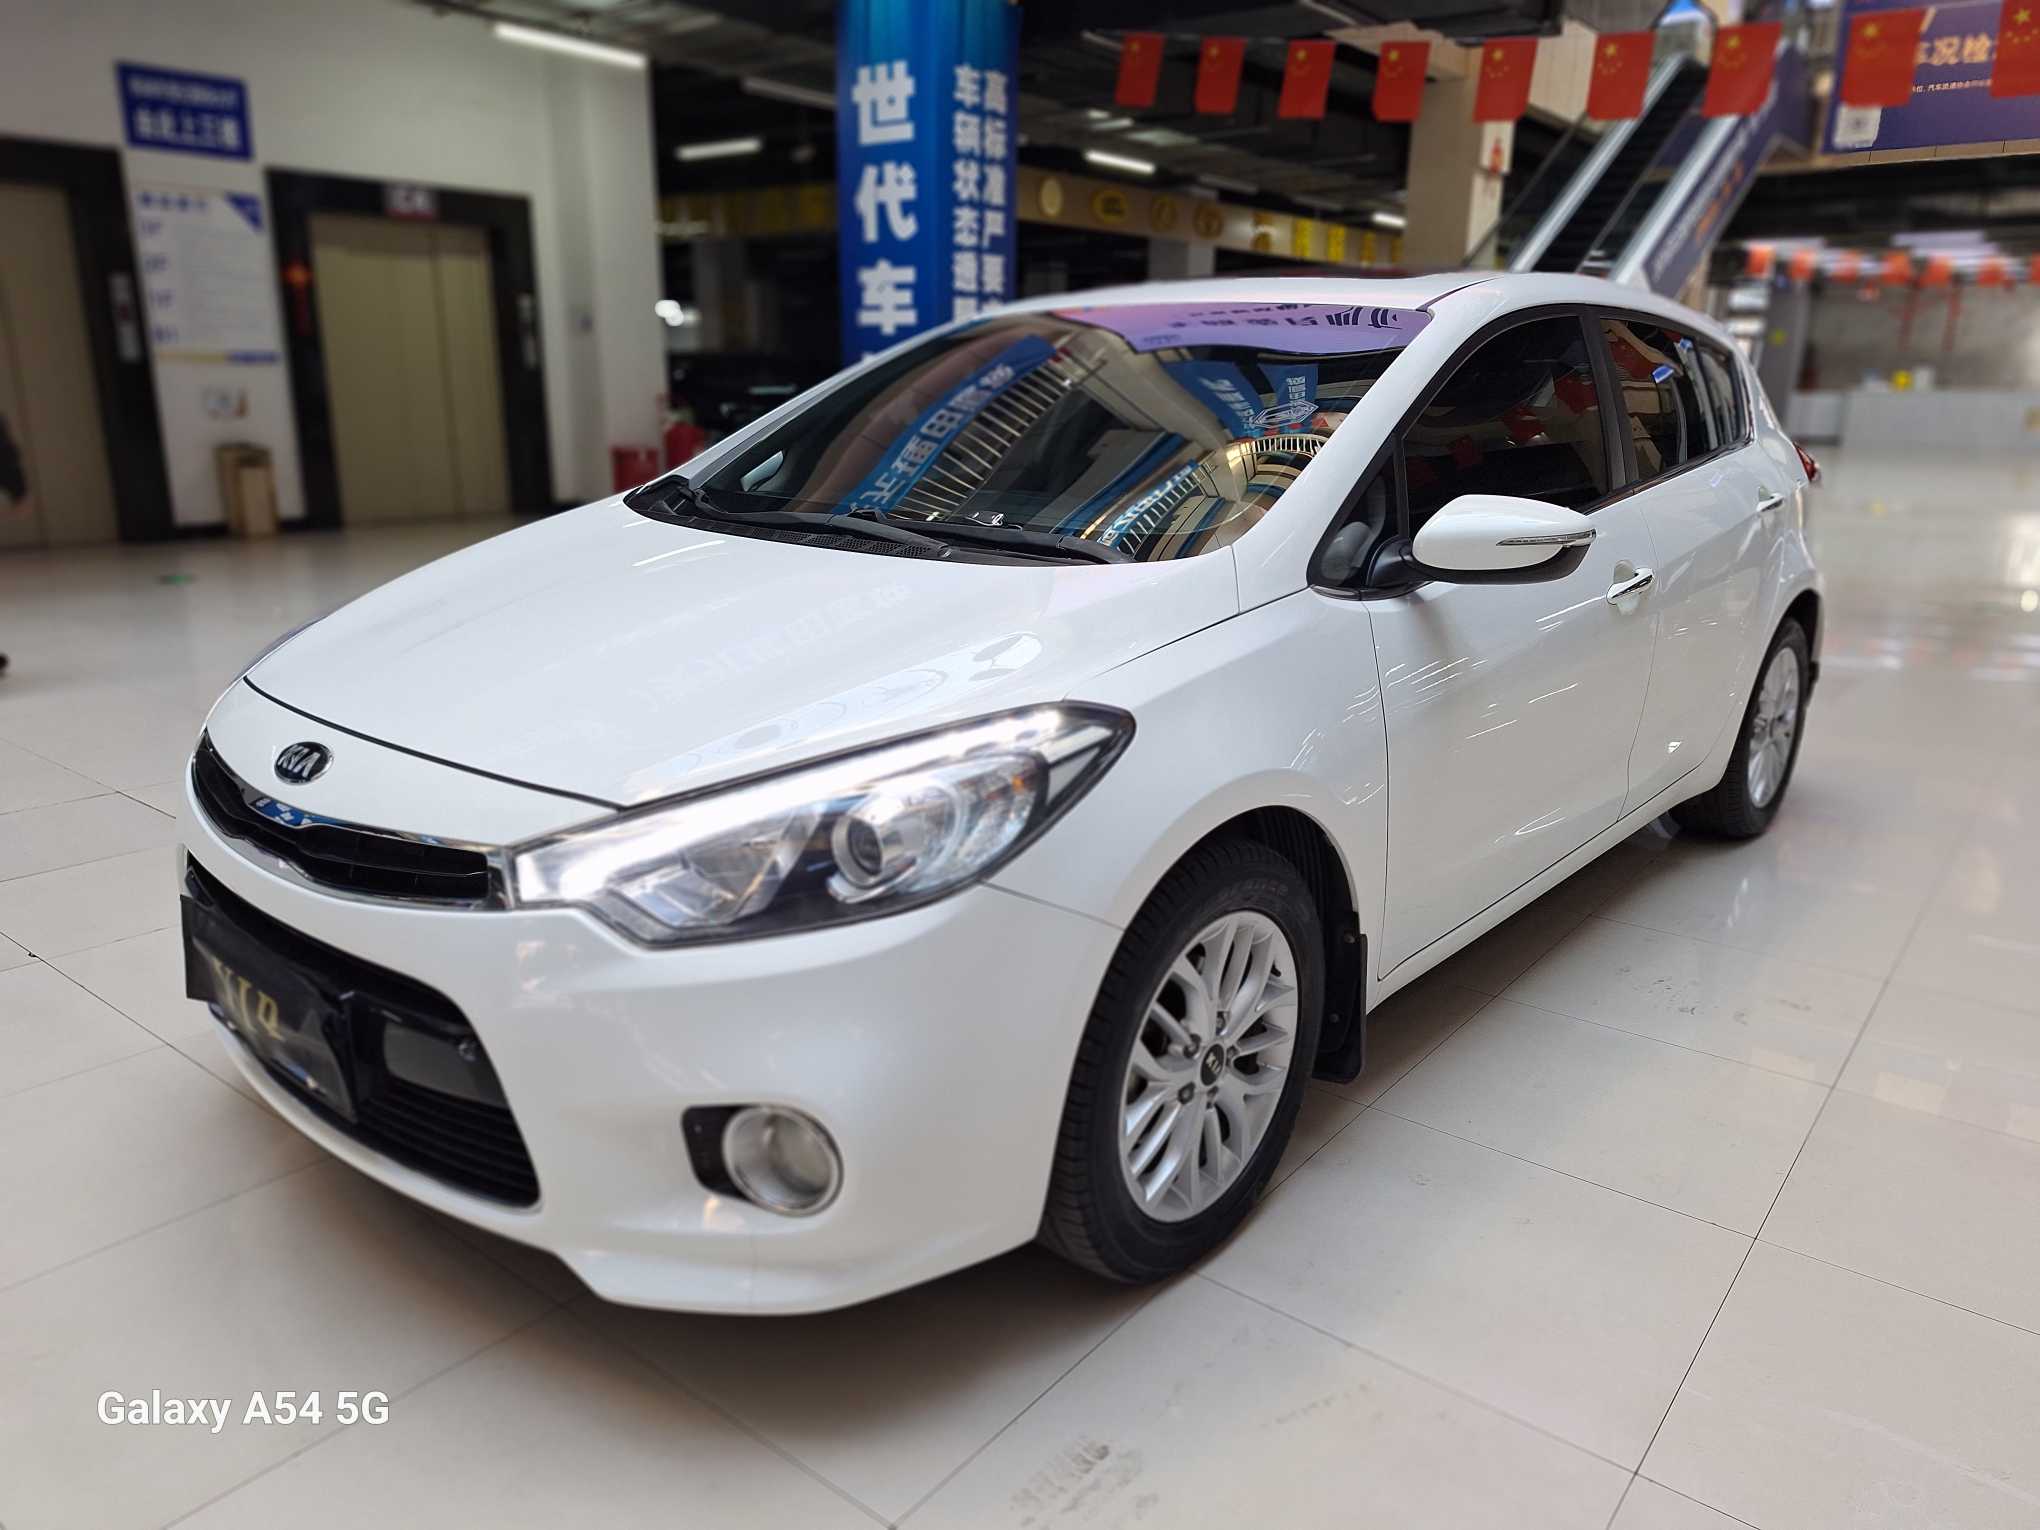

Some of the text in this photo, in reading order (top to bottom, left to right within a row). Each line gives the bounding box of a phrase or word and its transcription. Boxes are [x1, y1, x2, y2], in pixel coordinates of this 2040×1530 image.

[851, 60, 918, 363] 世代车
[982, 69, 1007, 313] 高标准严要
[277, 743, 320, 778] KIA
